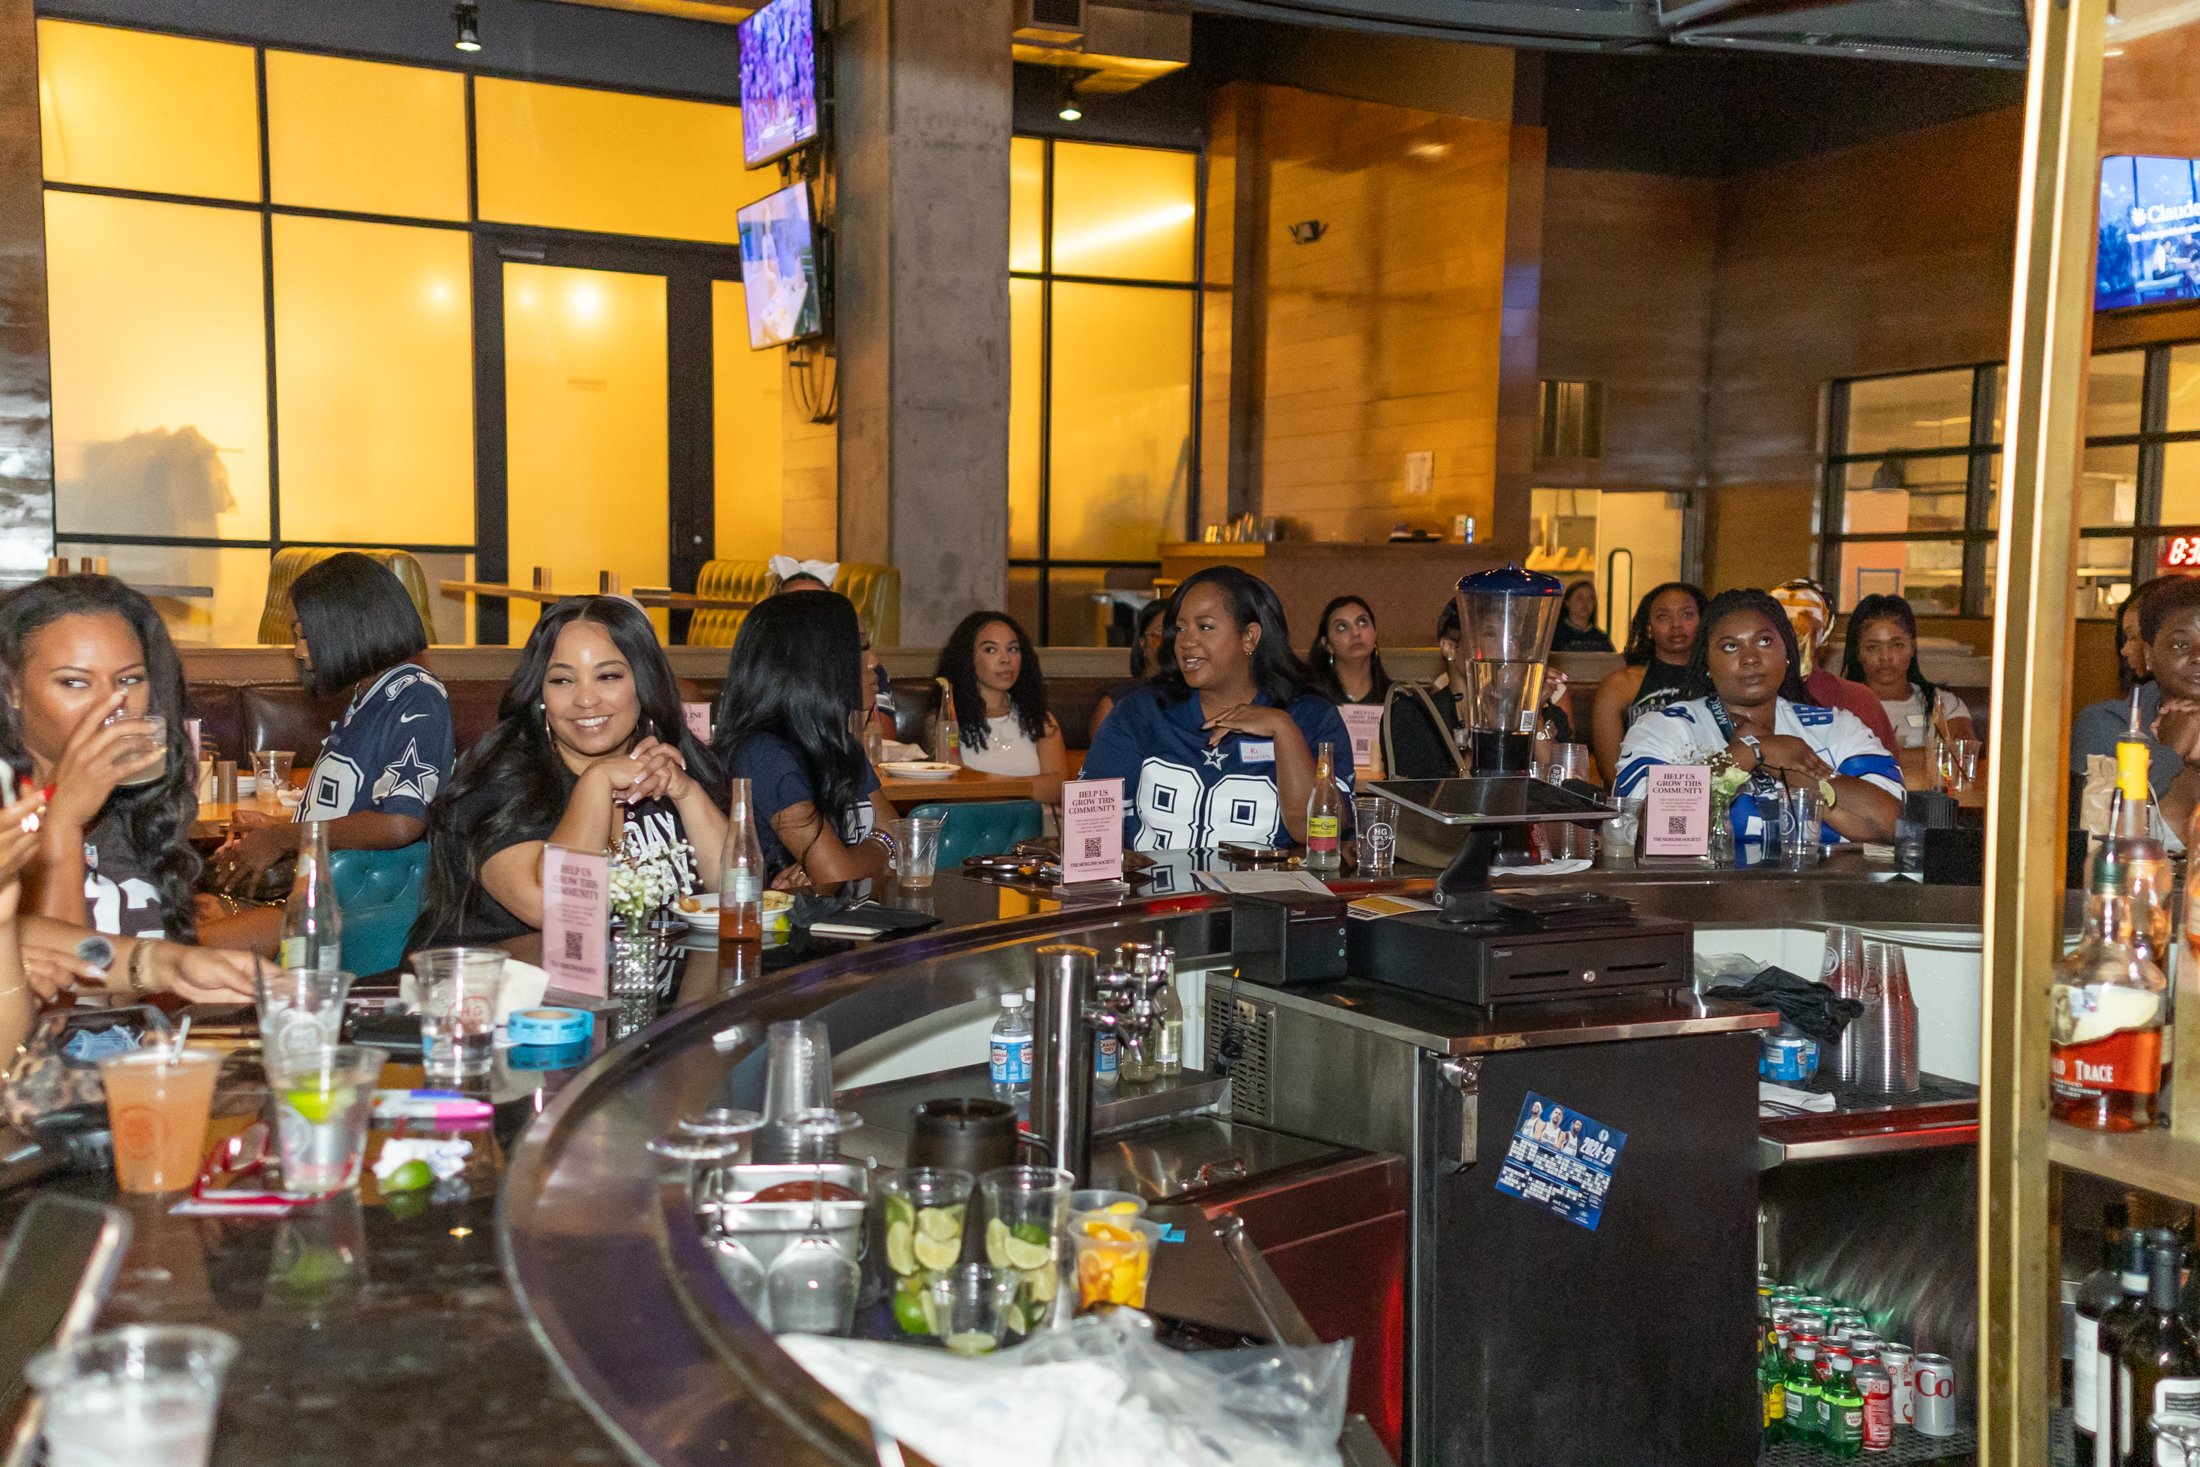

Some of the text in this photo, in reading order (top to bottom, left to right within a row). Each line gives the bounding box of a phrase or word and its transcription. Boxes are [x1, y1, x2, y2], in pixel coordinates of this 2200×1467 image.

[2147, 200, 2200, 224] Claude
[1079, 789, 1109, 798] HELP US
[1072, 797, 1115, 807] GROW THIS
[1068, 804, 1115, 815] COMMUNITY
[560, 864, 592, 877] HELP US
[580, 879, 599, 890] THIS
[2074, 1059, 2114, 1083] TRACE
[1580, 1137, 1617, 1165] 2024-25
